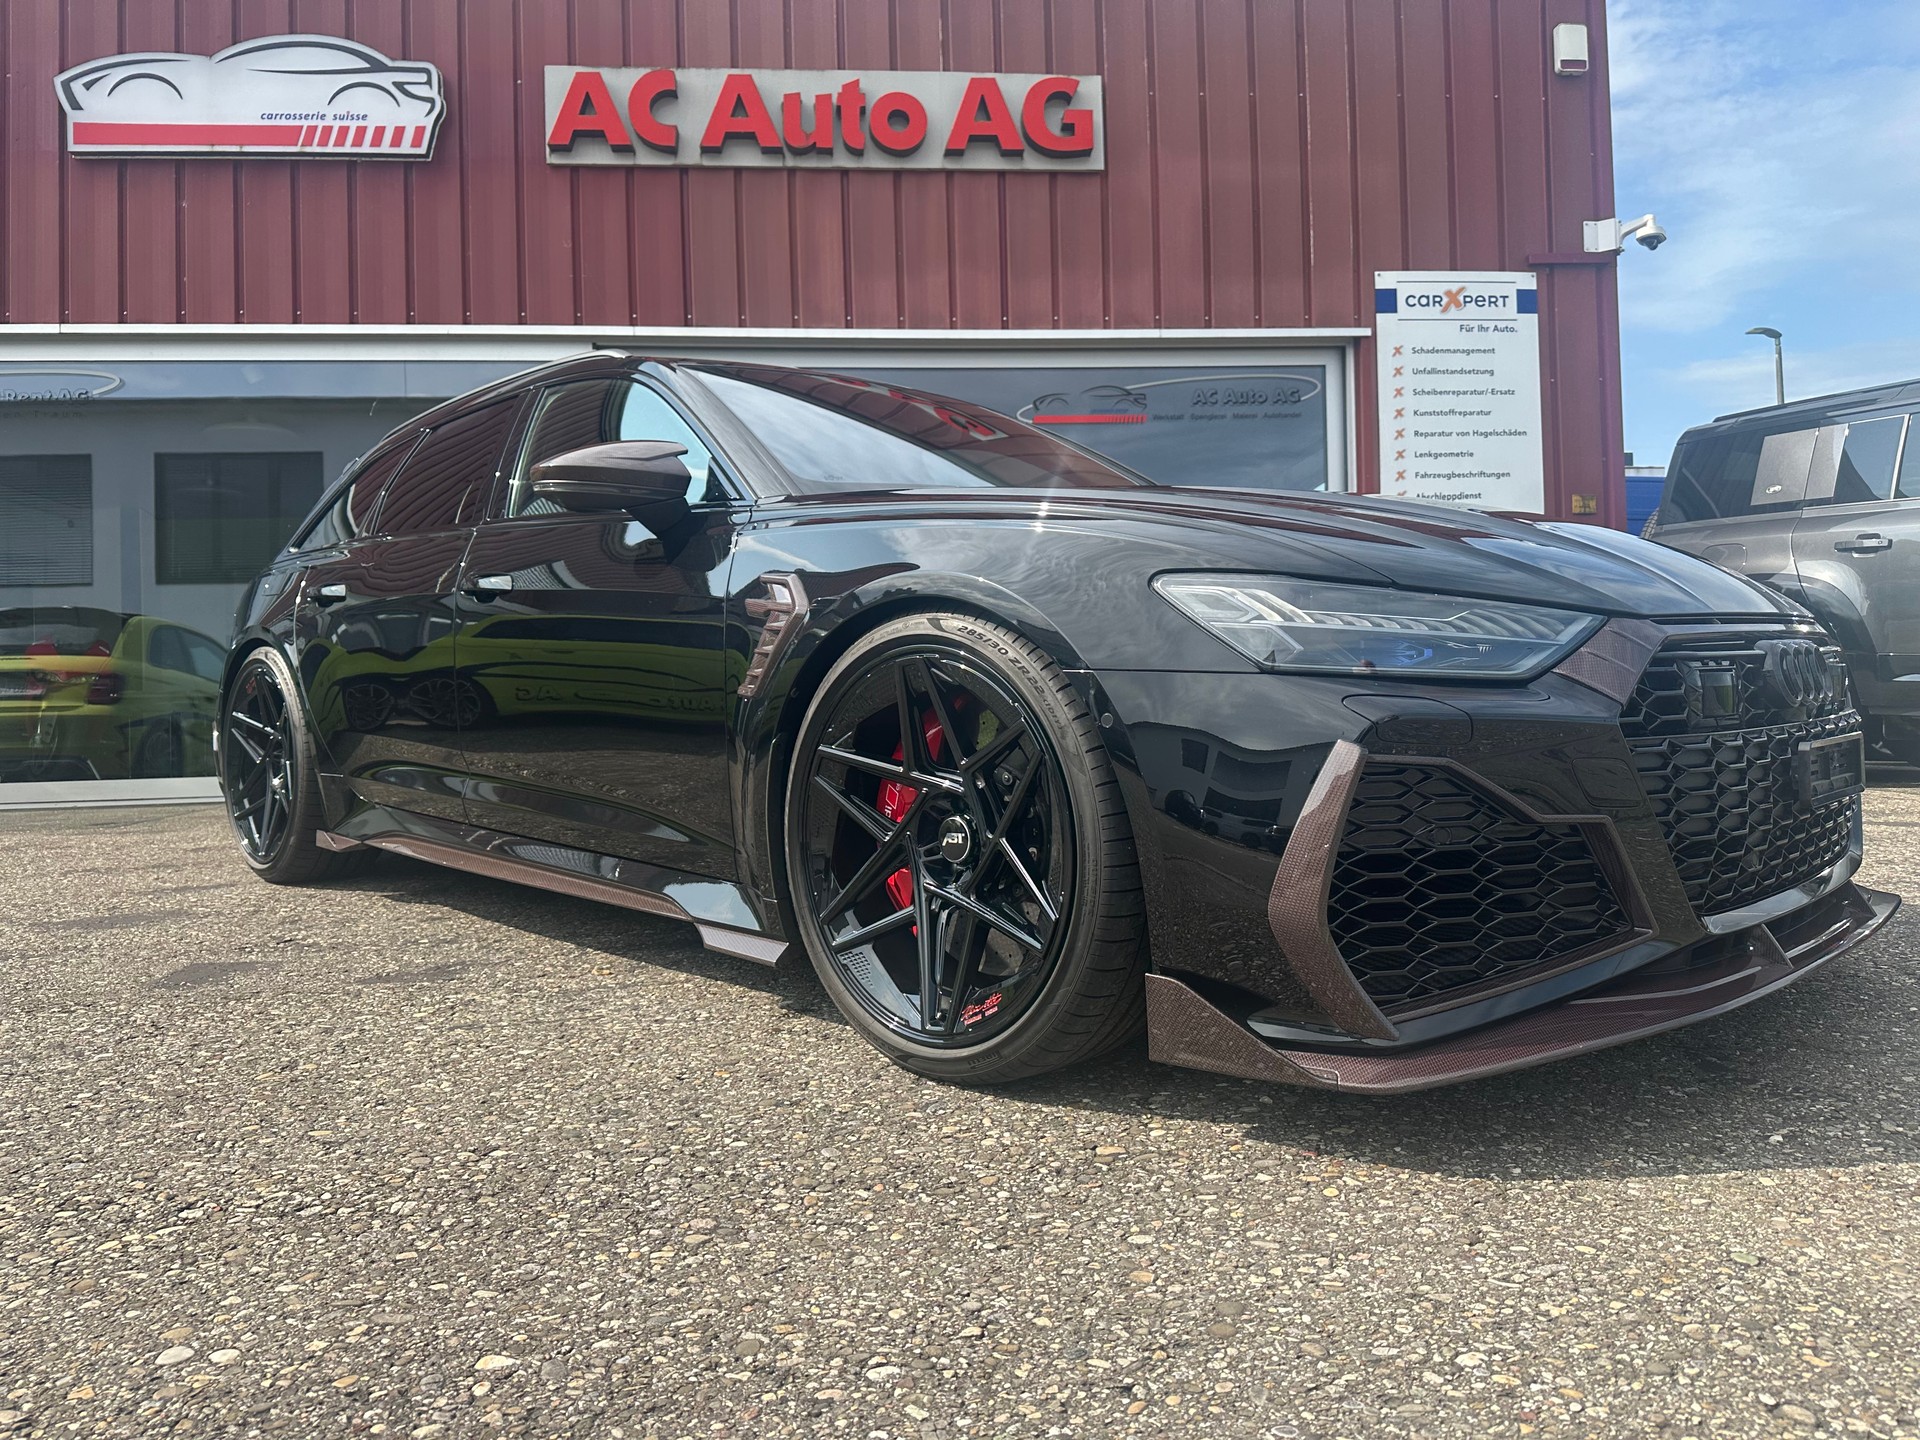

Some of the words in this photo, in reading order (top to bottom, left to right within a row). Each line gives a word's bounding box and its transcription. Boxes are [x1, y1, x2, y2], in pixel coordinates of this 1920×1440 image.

[260, 111, 326, 121] carrosserie
[332, 111, 368, 121] suisse
[548, 69, 679, 152] AC
[700, 74, 927, 155] Auto
[945, 77, 1094, 157] AG
[1459, 324, 1475, 333] Für
[1477, 324, 1490, 333] Ihr
[1492, 325, 1518, 333] Auto.
[1411, 346, 1496, 356] Schadenmanagement
[1412, 368, 1494, 377] Unfallinstandsetzung
[1192, 389, 1218, 406] AC
[1223, 388, 1268, 406] Auto
[1271, 388, 1301, 405] AG
[1412, 388, 1516, 398] Scheibenreparatur/-Ersatz
[1413, 408, 1492, 418] Kunststoffreparatur
[1414, 429, 1454, 439] Reparatur
[1472, 428, 1528, 438] Hagelschäden
[1414, 449, 1475, 460] Lenkgeometrie
[1414, 470, 1511, 480] Fahrzeugbeschriftungen
[957, 625, 1009, 656] 285/30
